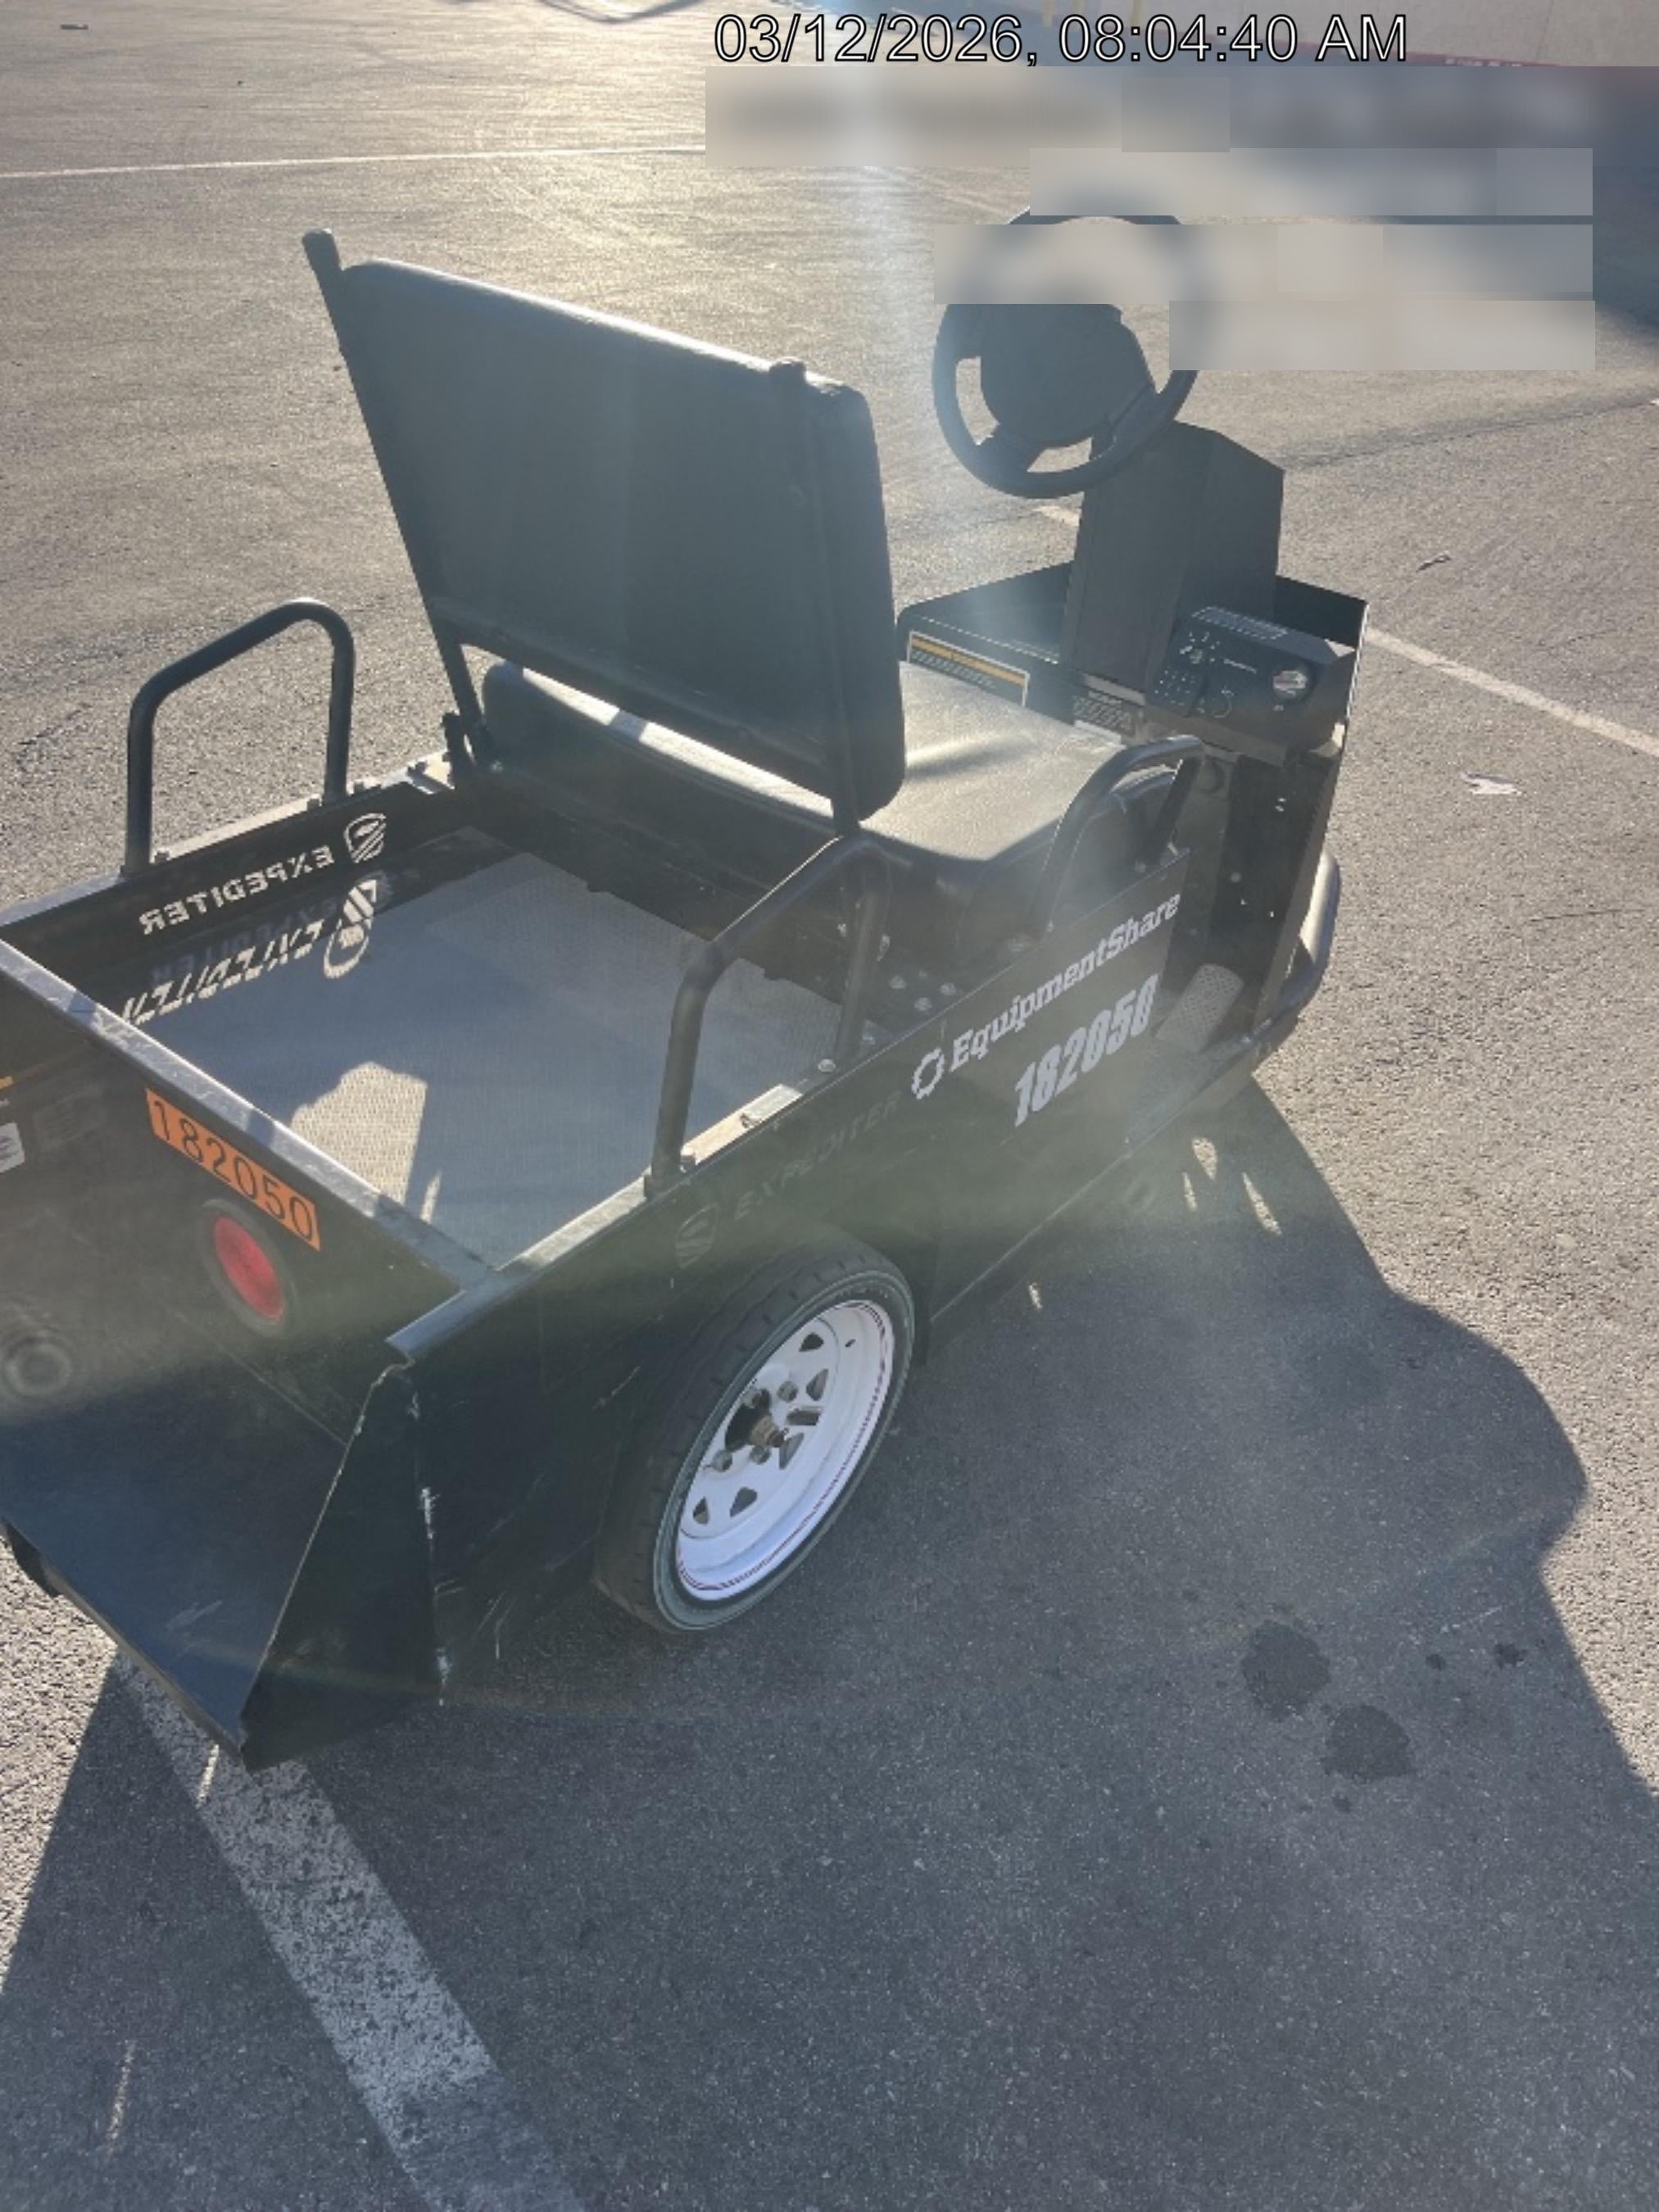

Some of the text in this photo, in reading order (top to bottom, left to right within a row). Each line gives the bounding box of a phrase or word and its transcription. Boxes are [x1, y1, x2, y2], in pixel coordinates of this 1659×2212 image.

[950, 894, 1181, 1072] EquipmentShare
[1014, 973, 1158, 1127] 182050
[154, 1100, 314, 1241] 182050
